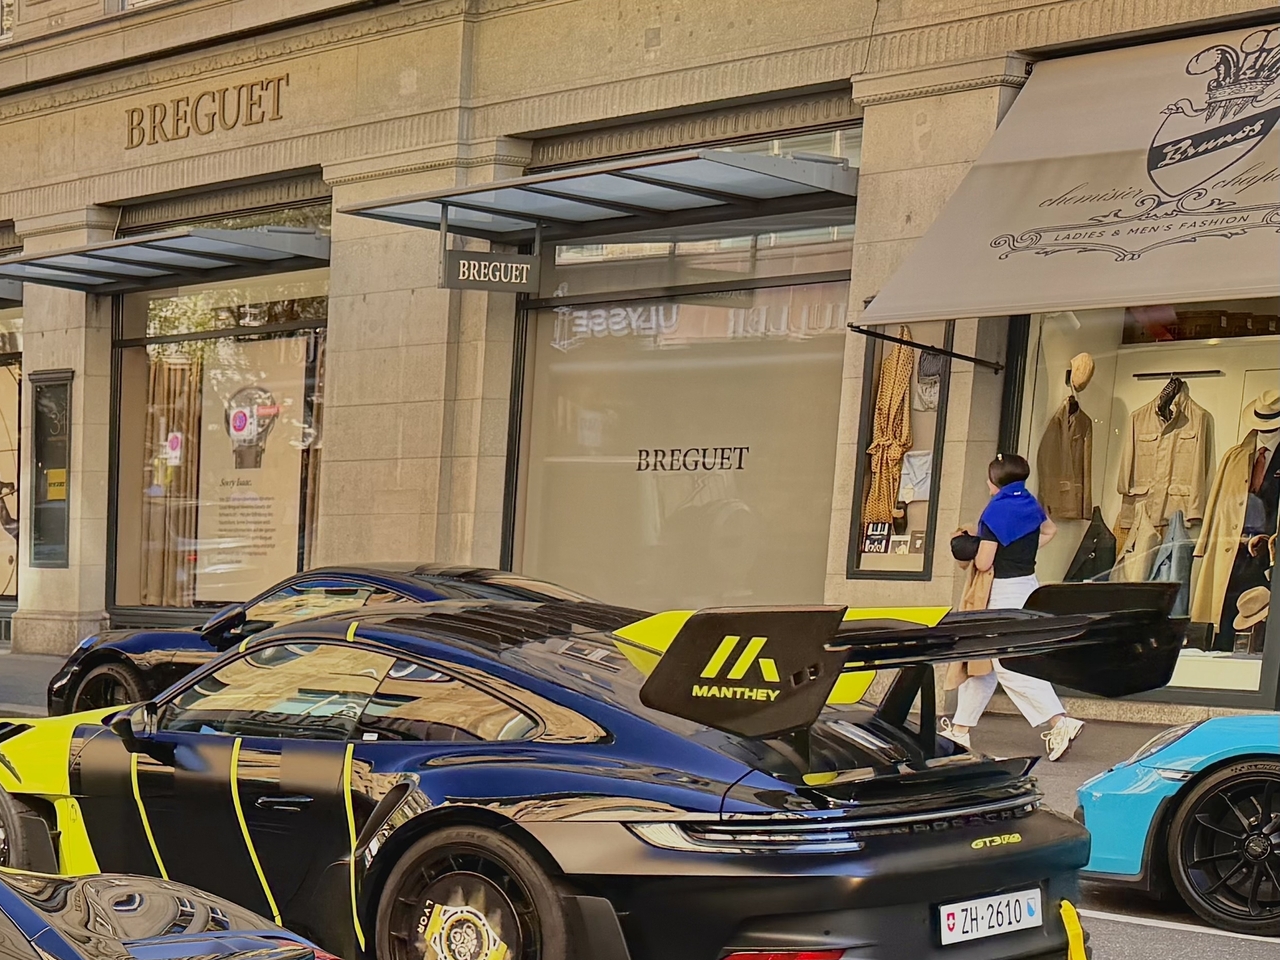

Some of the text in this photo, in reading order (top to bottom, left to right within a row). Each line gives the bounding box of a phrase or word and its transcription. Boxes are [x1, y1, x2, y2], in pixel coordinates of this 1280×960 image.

[124, 73, 289, 150] BREGUET
[1053, 214, 1251, 242] LADIES & MEN'S FASHION
[458, 260, 531, 284] BREGUET
[636, 446, 750, 472] BREGUET
[692, 684, 780, 702] MANTHEY
